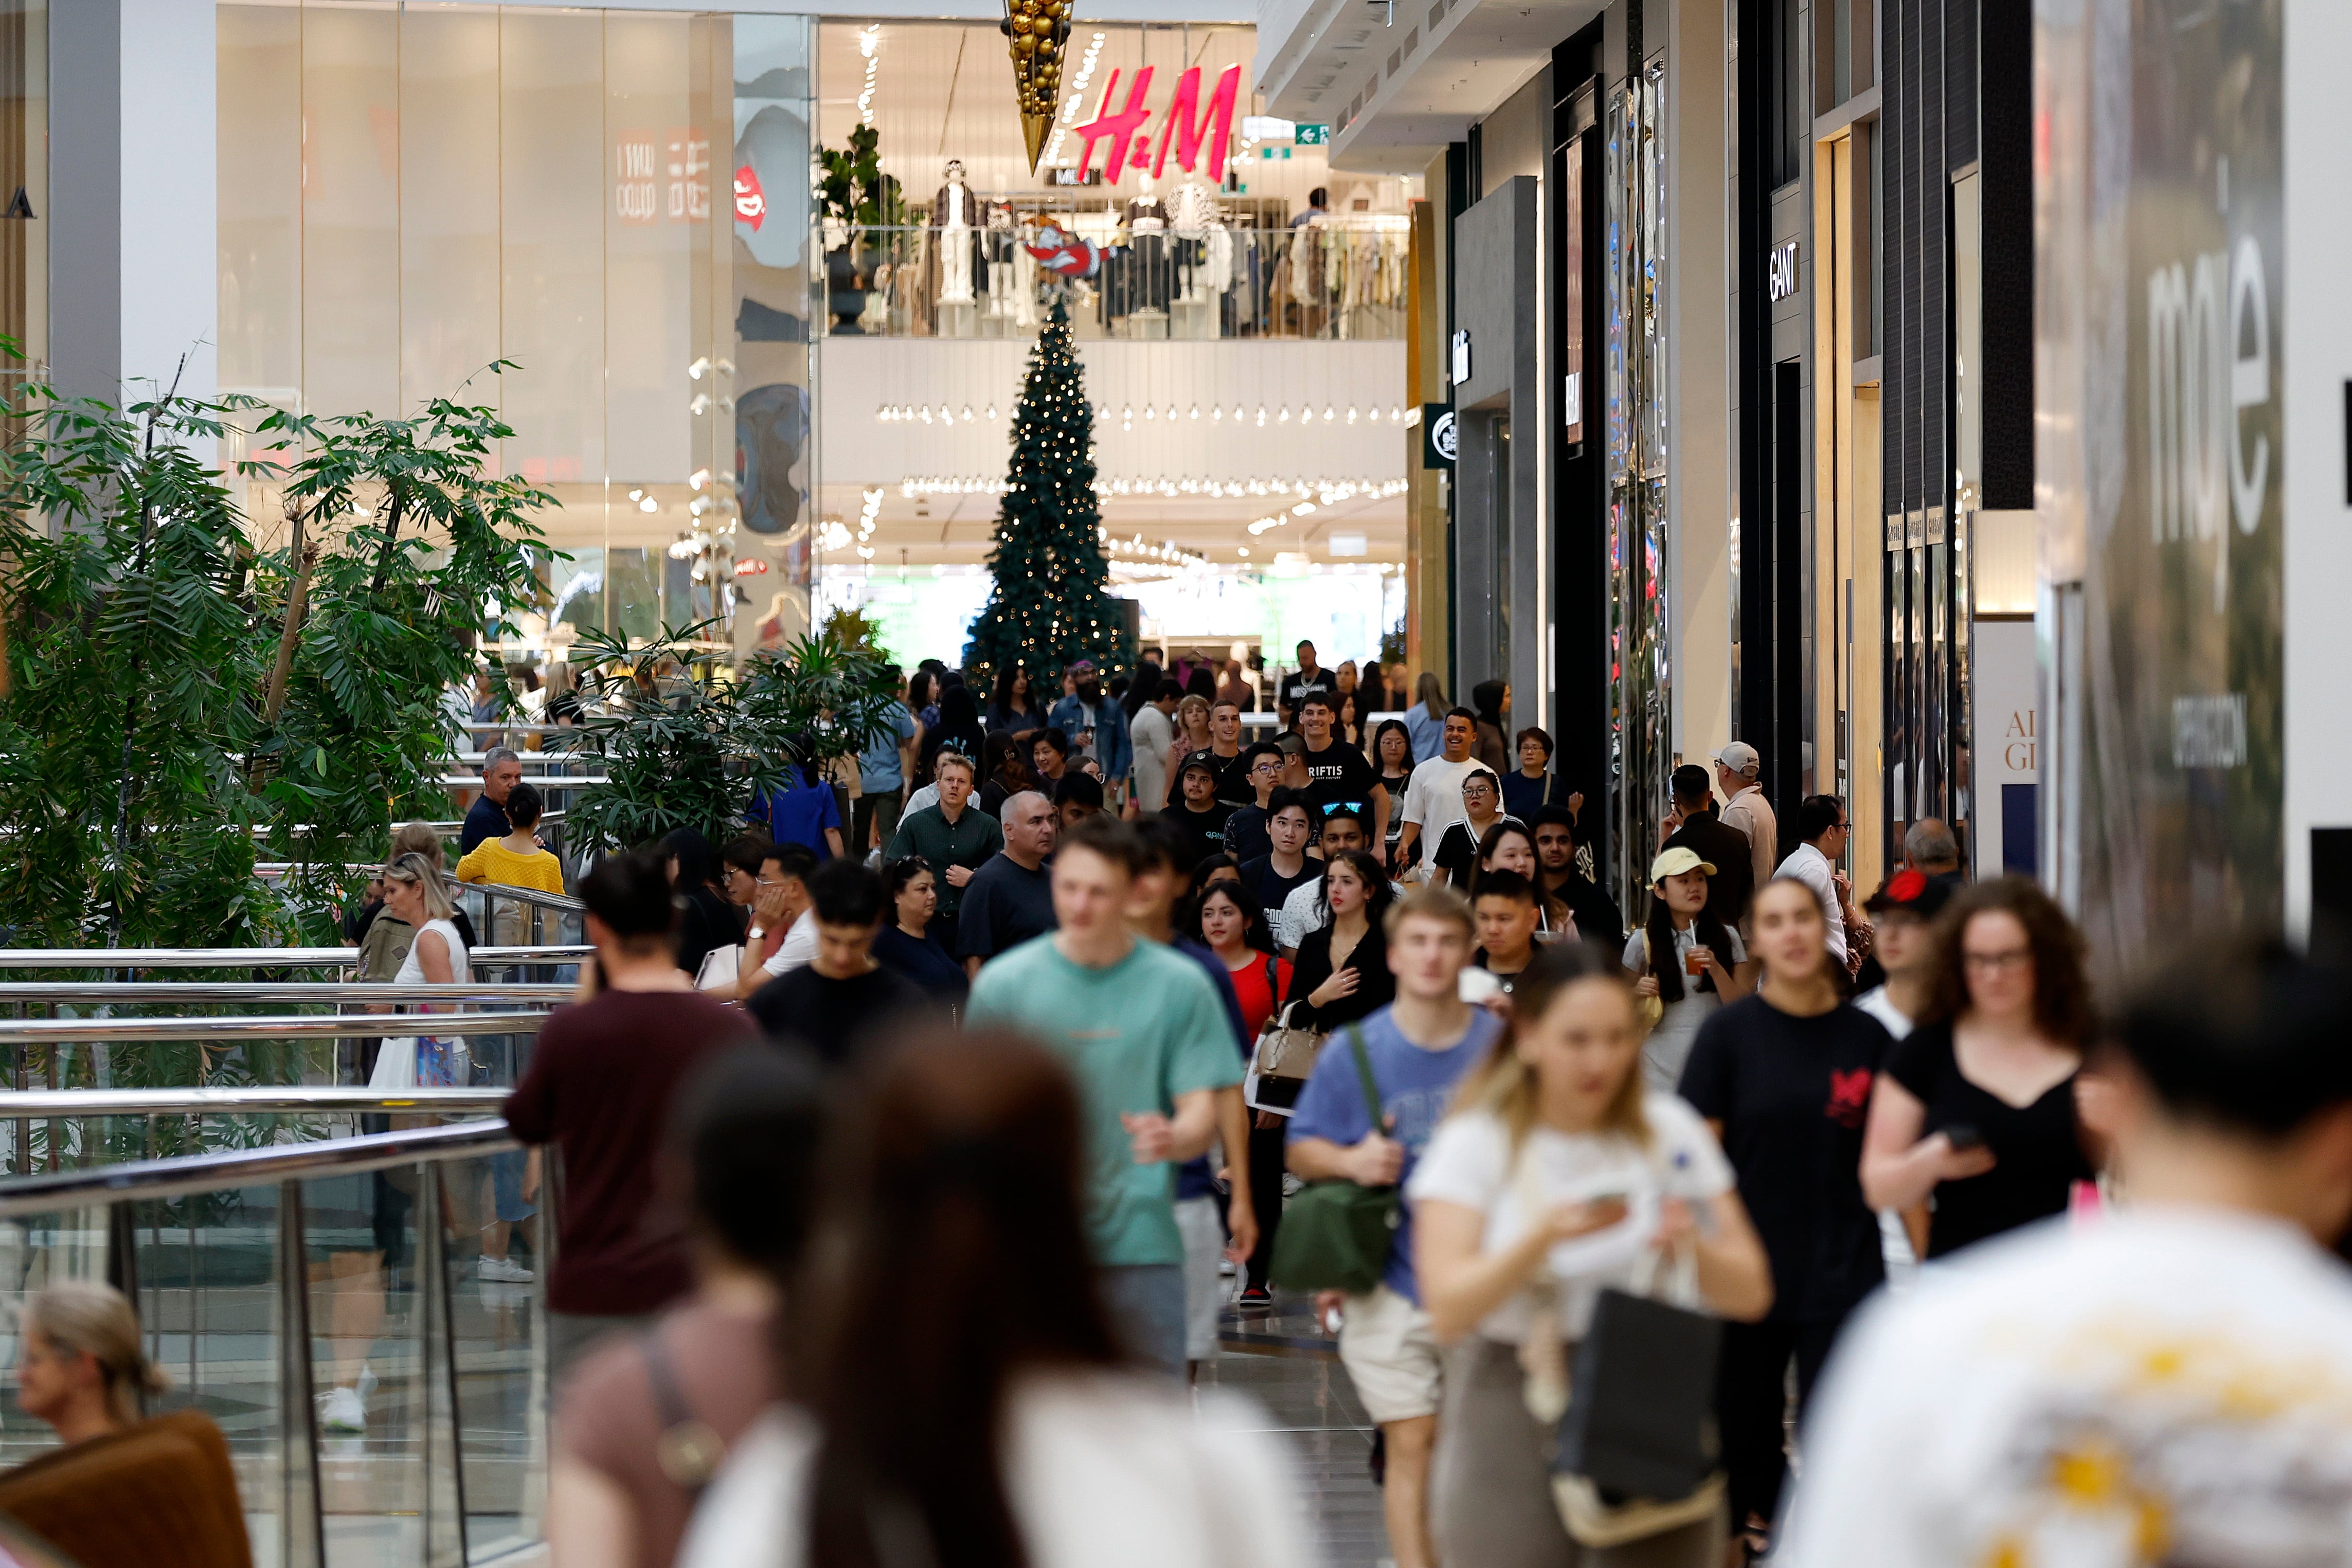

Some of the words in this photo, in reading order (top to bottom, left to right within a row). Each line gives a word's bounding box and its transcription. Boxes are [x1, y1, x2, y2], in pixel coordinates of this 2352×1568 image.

[1071, 62, 1241, 185] H&M
[1770, 242, 1797, 302] GANT
[1442, 432, 1457, 443] BO
[1443, 443, 1457, 452] SH
[1308, 765, 1342, 777] RIFTIS
